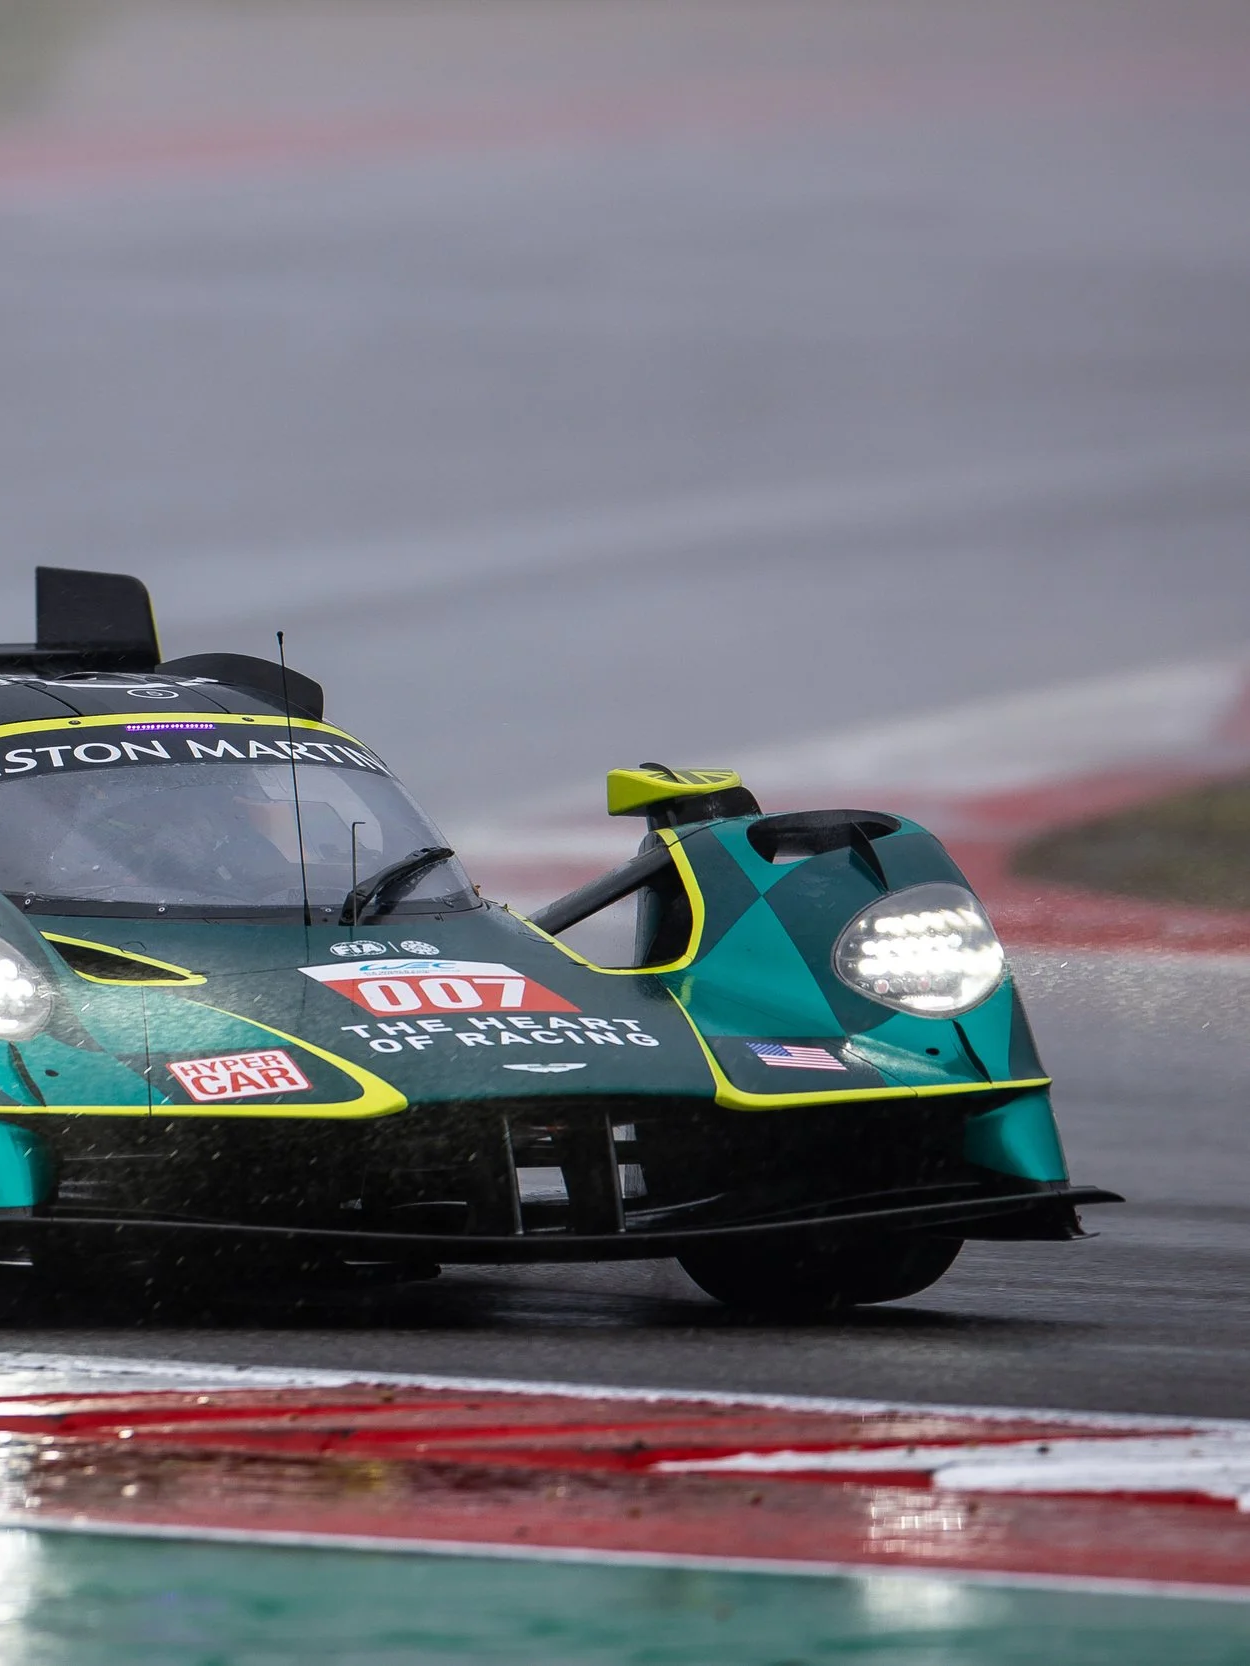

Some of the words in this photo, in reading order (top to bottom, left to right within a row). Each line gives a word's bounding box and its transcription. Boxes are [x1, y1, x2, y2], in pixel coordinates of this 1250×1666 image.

[186, 739, 394, 778] MARTIN
[332, 941, 382, 956] FIA
[359, 961, 457, 972] WEC
[357, 977, 526, 1013] 007
[341, 1018, 453, 1039] THE
[467, 1016, 643, 1032] HEART
[369, 1034, 434, 1054] OF
[455, 1029, 661, 1048] RACING
[178, 1054, 284, 1077] HYPER
[191, 1067, 300, 1096] CAR
